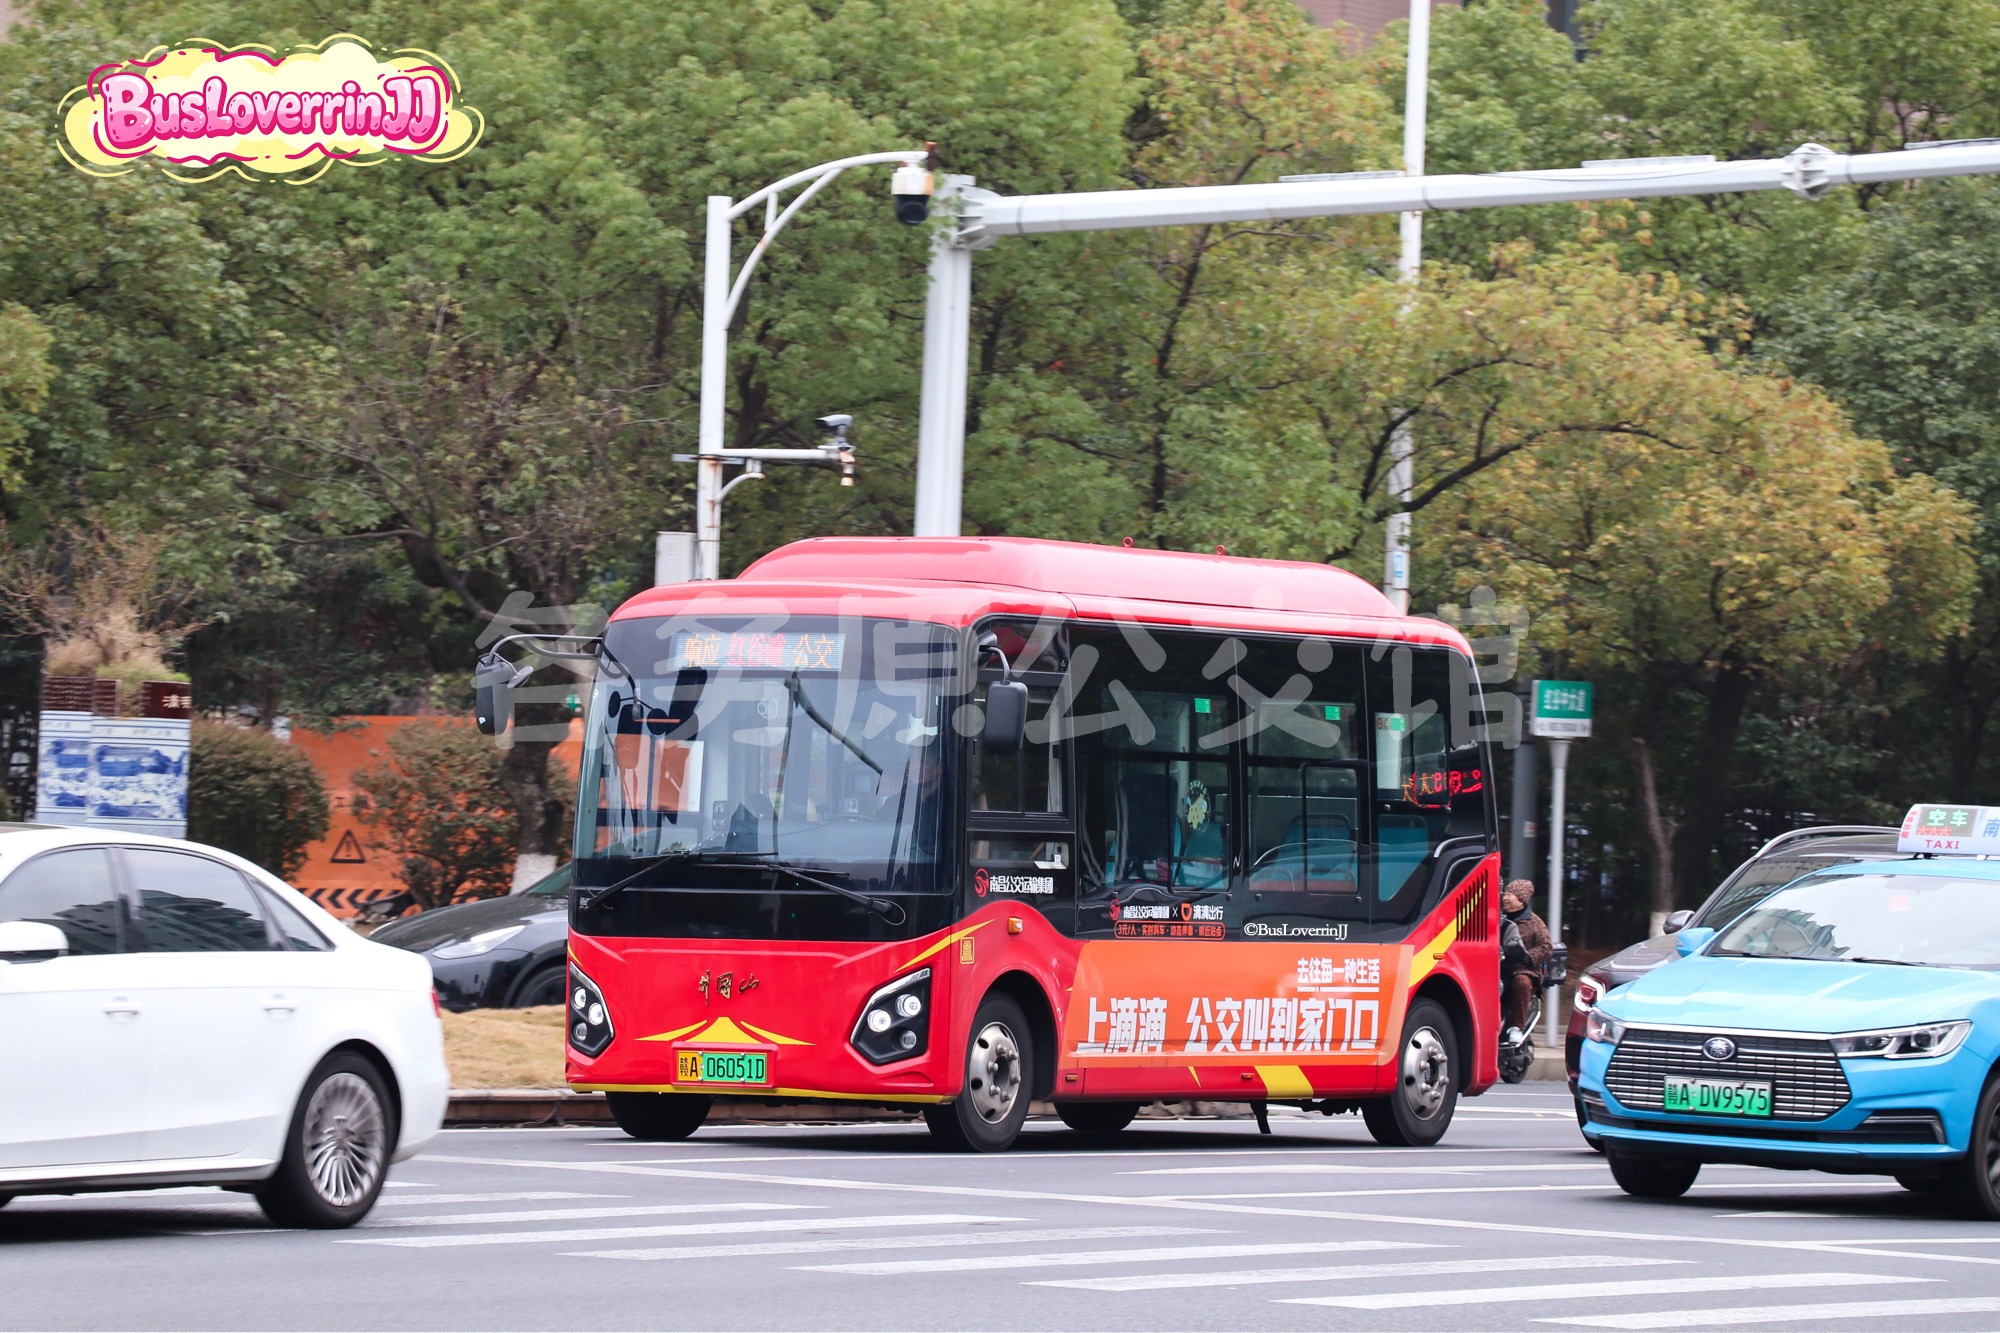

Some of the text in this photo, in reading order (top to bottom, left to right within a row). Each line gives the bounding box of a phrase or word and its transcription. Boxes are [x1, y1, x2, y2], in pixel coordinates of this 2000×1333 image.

[793, 633, 835, 669] 公交
[1926, 808, 1969, 827] 空车
[1924, 839, 1960, 850] TAXI
[1193, 905, 1224, 920] 滴滴出行
[1297, 957, 1380, 984] 去往每一种生活
[1075, 996, 1380, 1054] 上滴滴 公交叫到家门口
